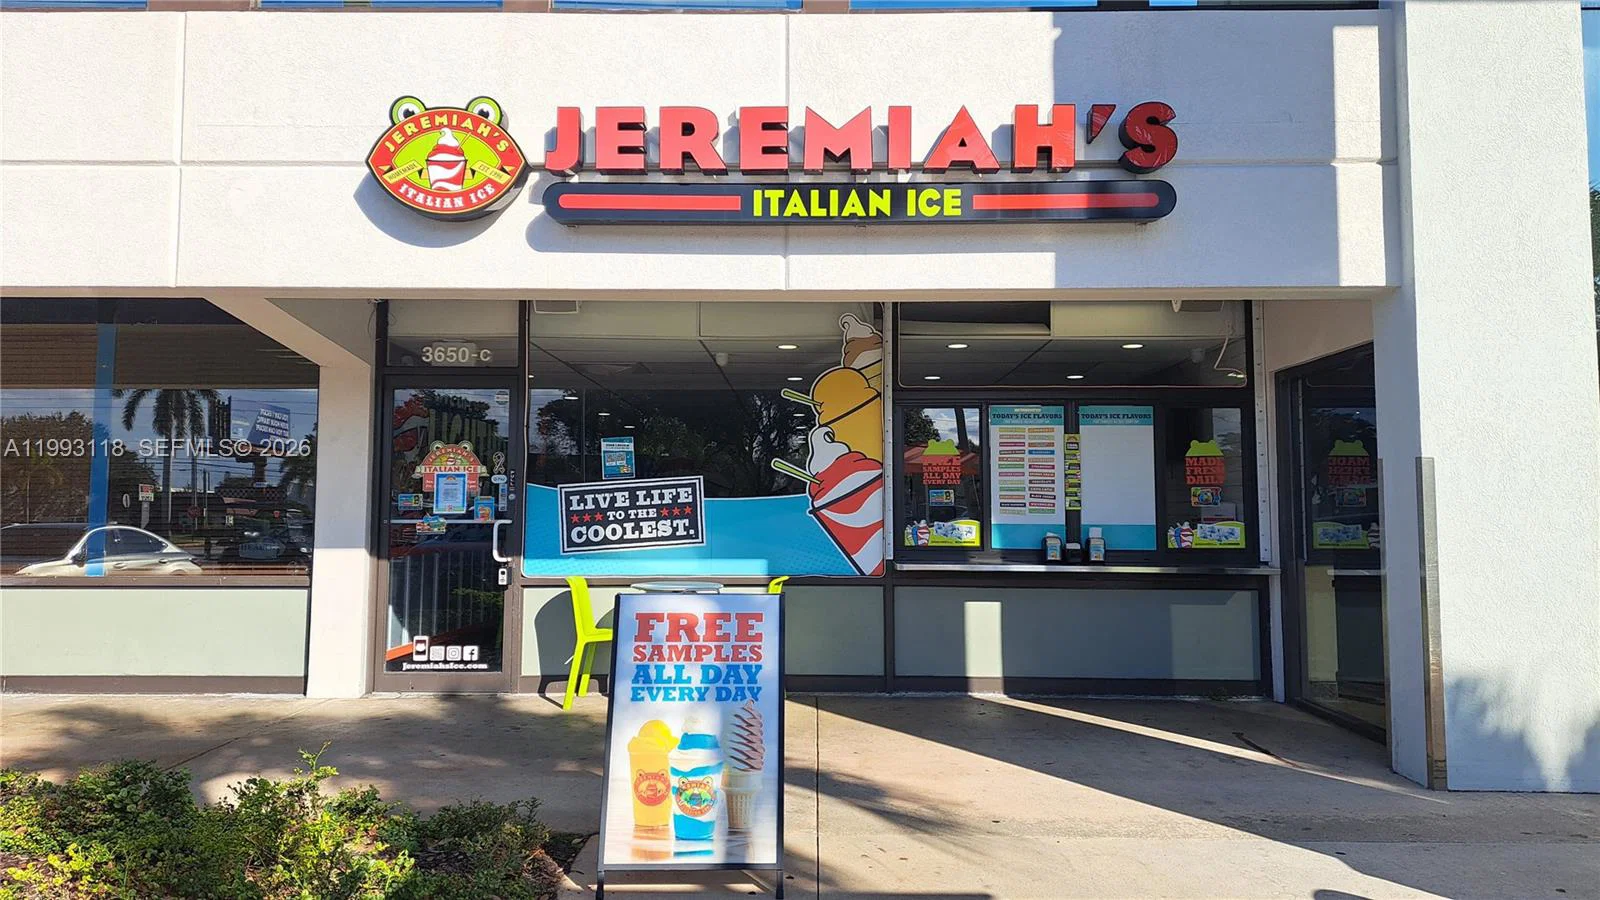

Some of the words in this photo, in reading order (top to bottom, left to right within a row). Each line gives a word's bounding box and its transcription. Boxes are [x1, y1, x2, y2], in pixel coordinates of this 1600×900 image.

[384, 114, 509, 152] JEREMIAH'S
[544, 102, 1178, 173] JEREMIAH'S
[398, 184, 464, 208] ITALIAN
[469, 183, 496, 204] ICE
[753, 188, 891, 217] ITALIAN
[906, 188, 962, 217] ICE
[1186, 467, 1224, 475] FRES
[569, 491, 630, 511] LIVE
[636, 487, 693, 506] LIFE
[607, 510, 625, 521] TO
[628, 508, 657, 519] THE
[570, 518, 695, 544] COOLEST.
[633, 612, 764, 643] FREE
[632, 644, 763, 662] SAMPLES
[631, 664, 692, 685] ALL
[700, 664, 763, 685] DAY
[630, 686, 709, 702] EVERY
[714, 686, 762, 702] DAY
